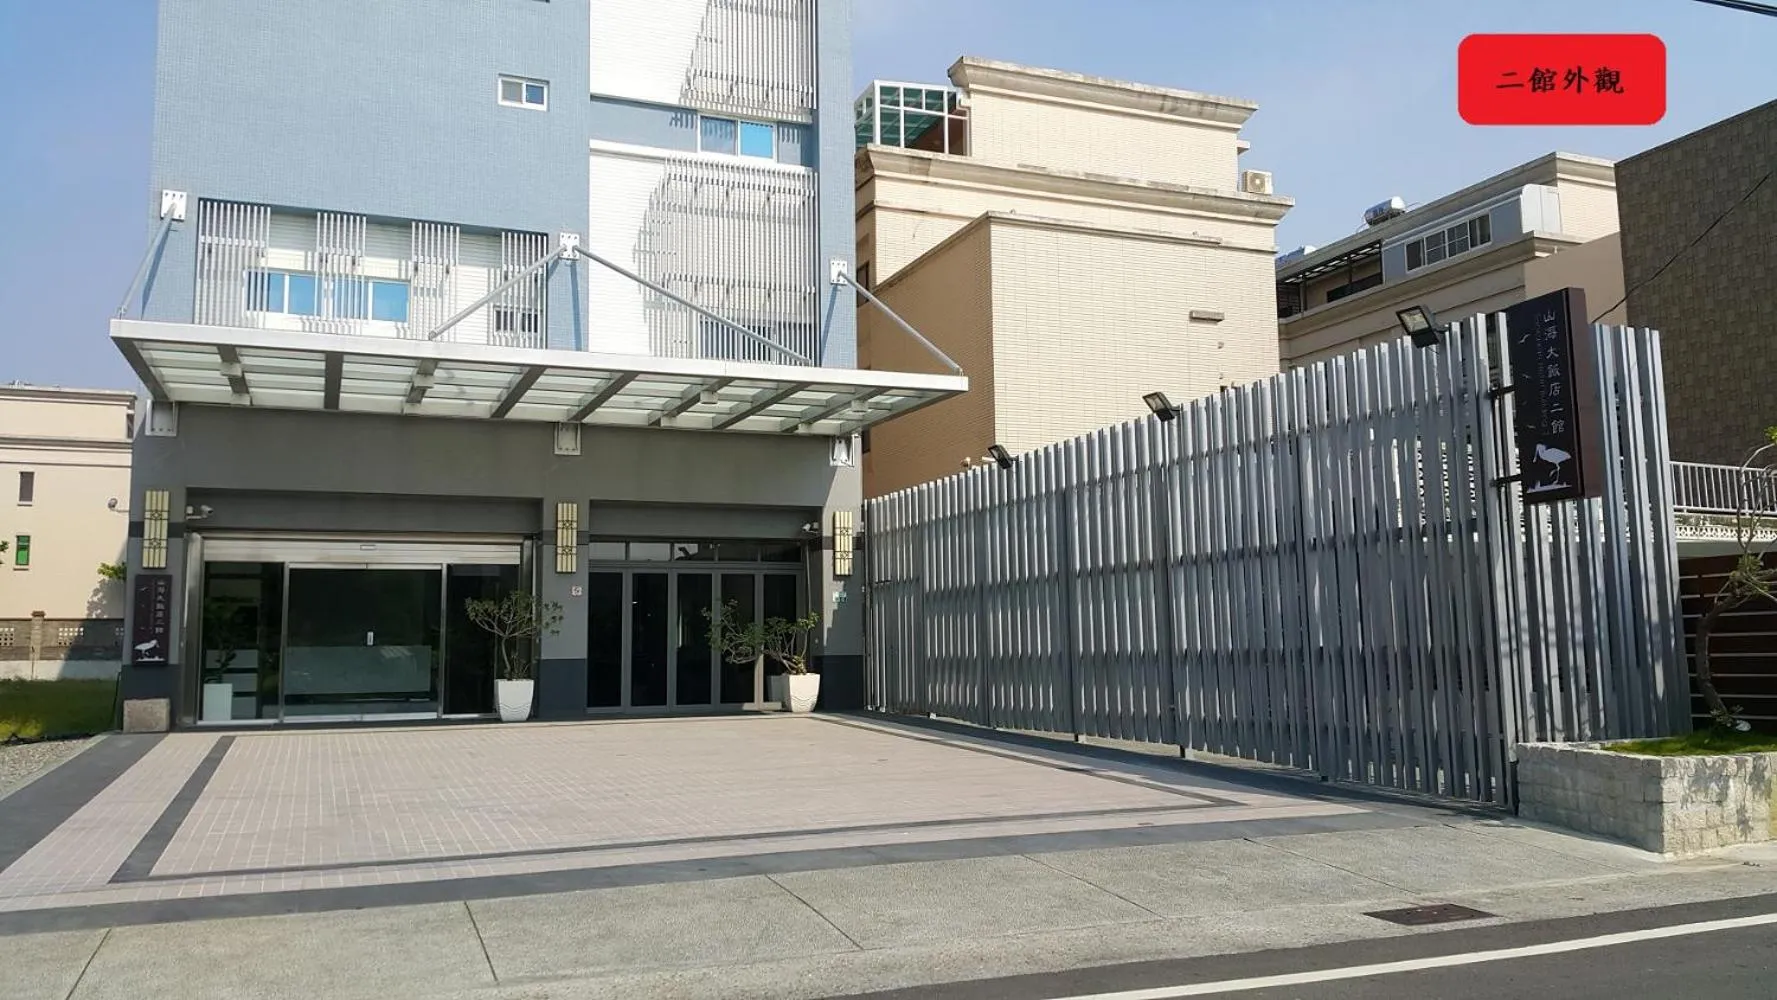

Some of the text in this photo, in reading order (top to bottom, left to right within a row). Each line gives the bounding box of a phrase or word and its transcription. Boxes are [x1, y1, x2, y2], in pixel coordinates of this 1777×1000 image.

[1543, 310, 1565, 434] 山海大飯店二館
